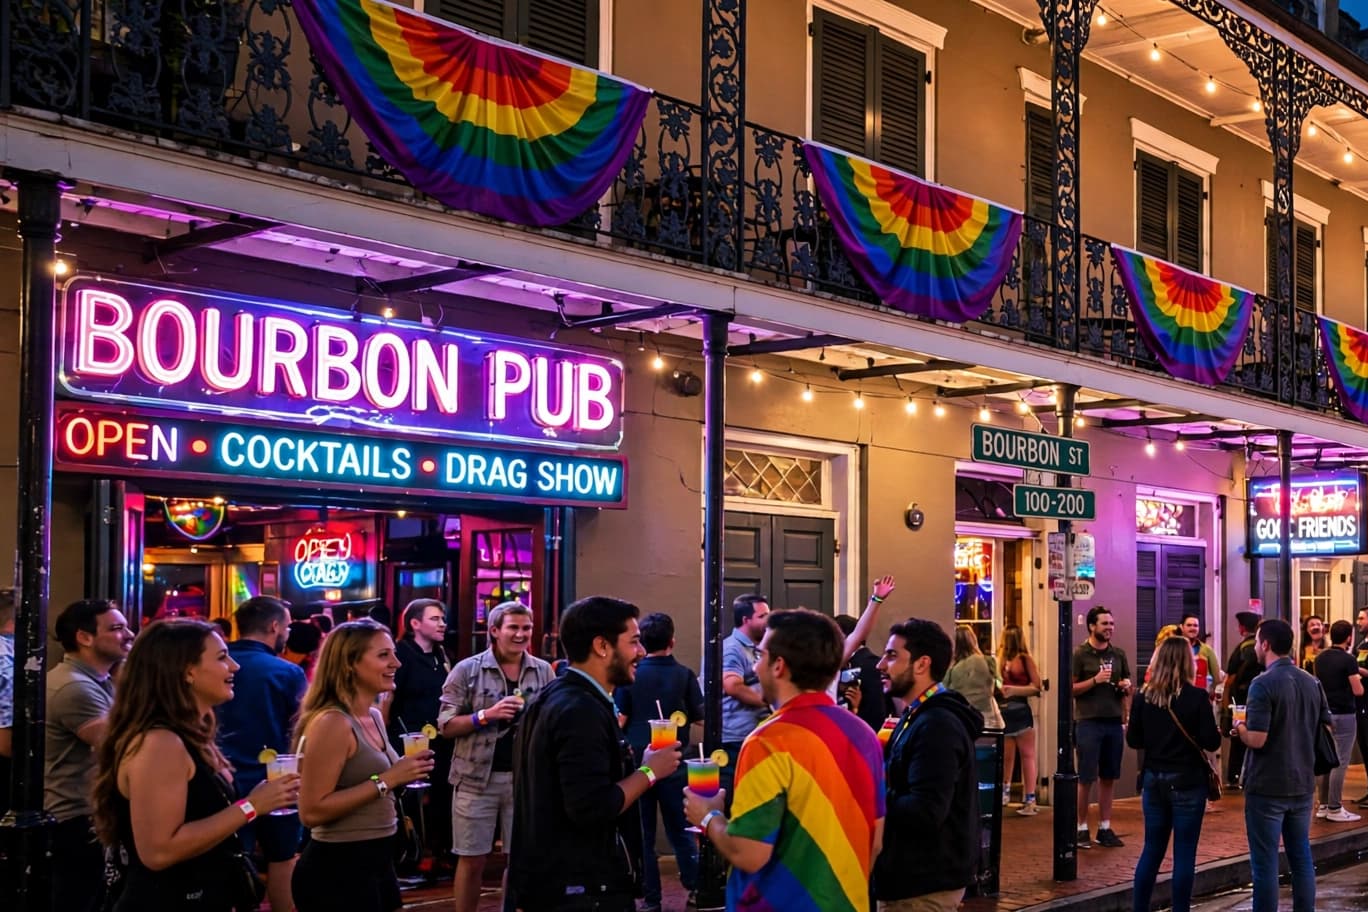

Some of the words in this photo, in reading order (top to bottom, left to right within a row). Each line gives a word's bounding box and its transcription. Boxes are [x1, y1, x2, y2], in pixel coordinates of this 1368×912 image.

[73, 289, 459, 414] BOURBON
[486, 350, 614, 430] PUB
[65, 417, 178, 462] OPEN
[221, 432, 411, 480] COCKTAILS
[446, 452, 527, 489] DRAG
[537, 461, 617, 495] SHOW
[982, 430, 1060, 466] BOURBON
[1068, 447, 1083, 466] ST
[1025, 491, 1085, 514] 100-200
[1298, 515, 1356, 538] FRIENDS
